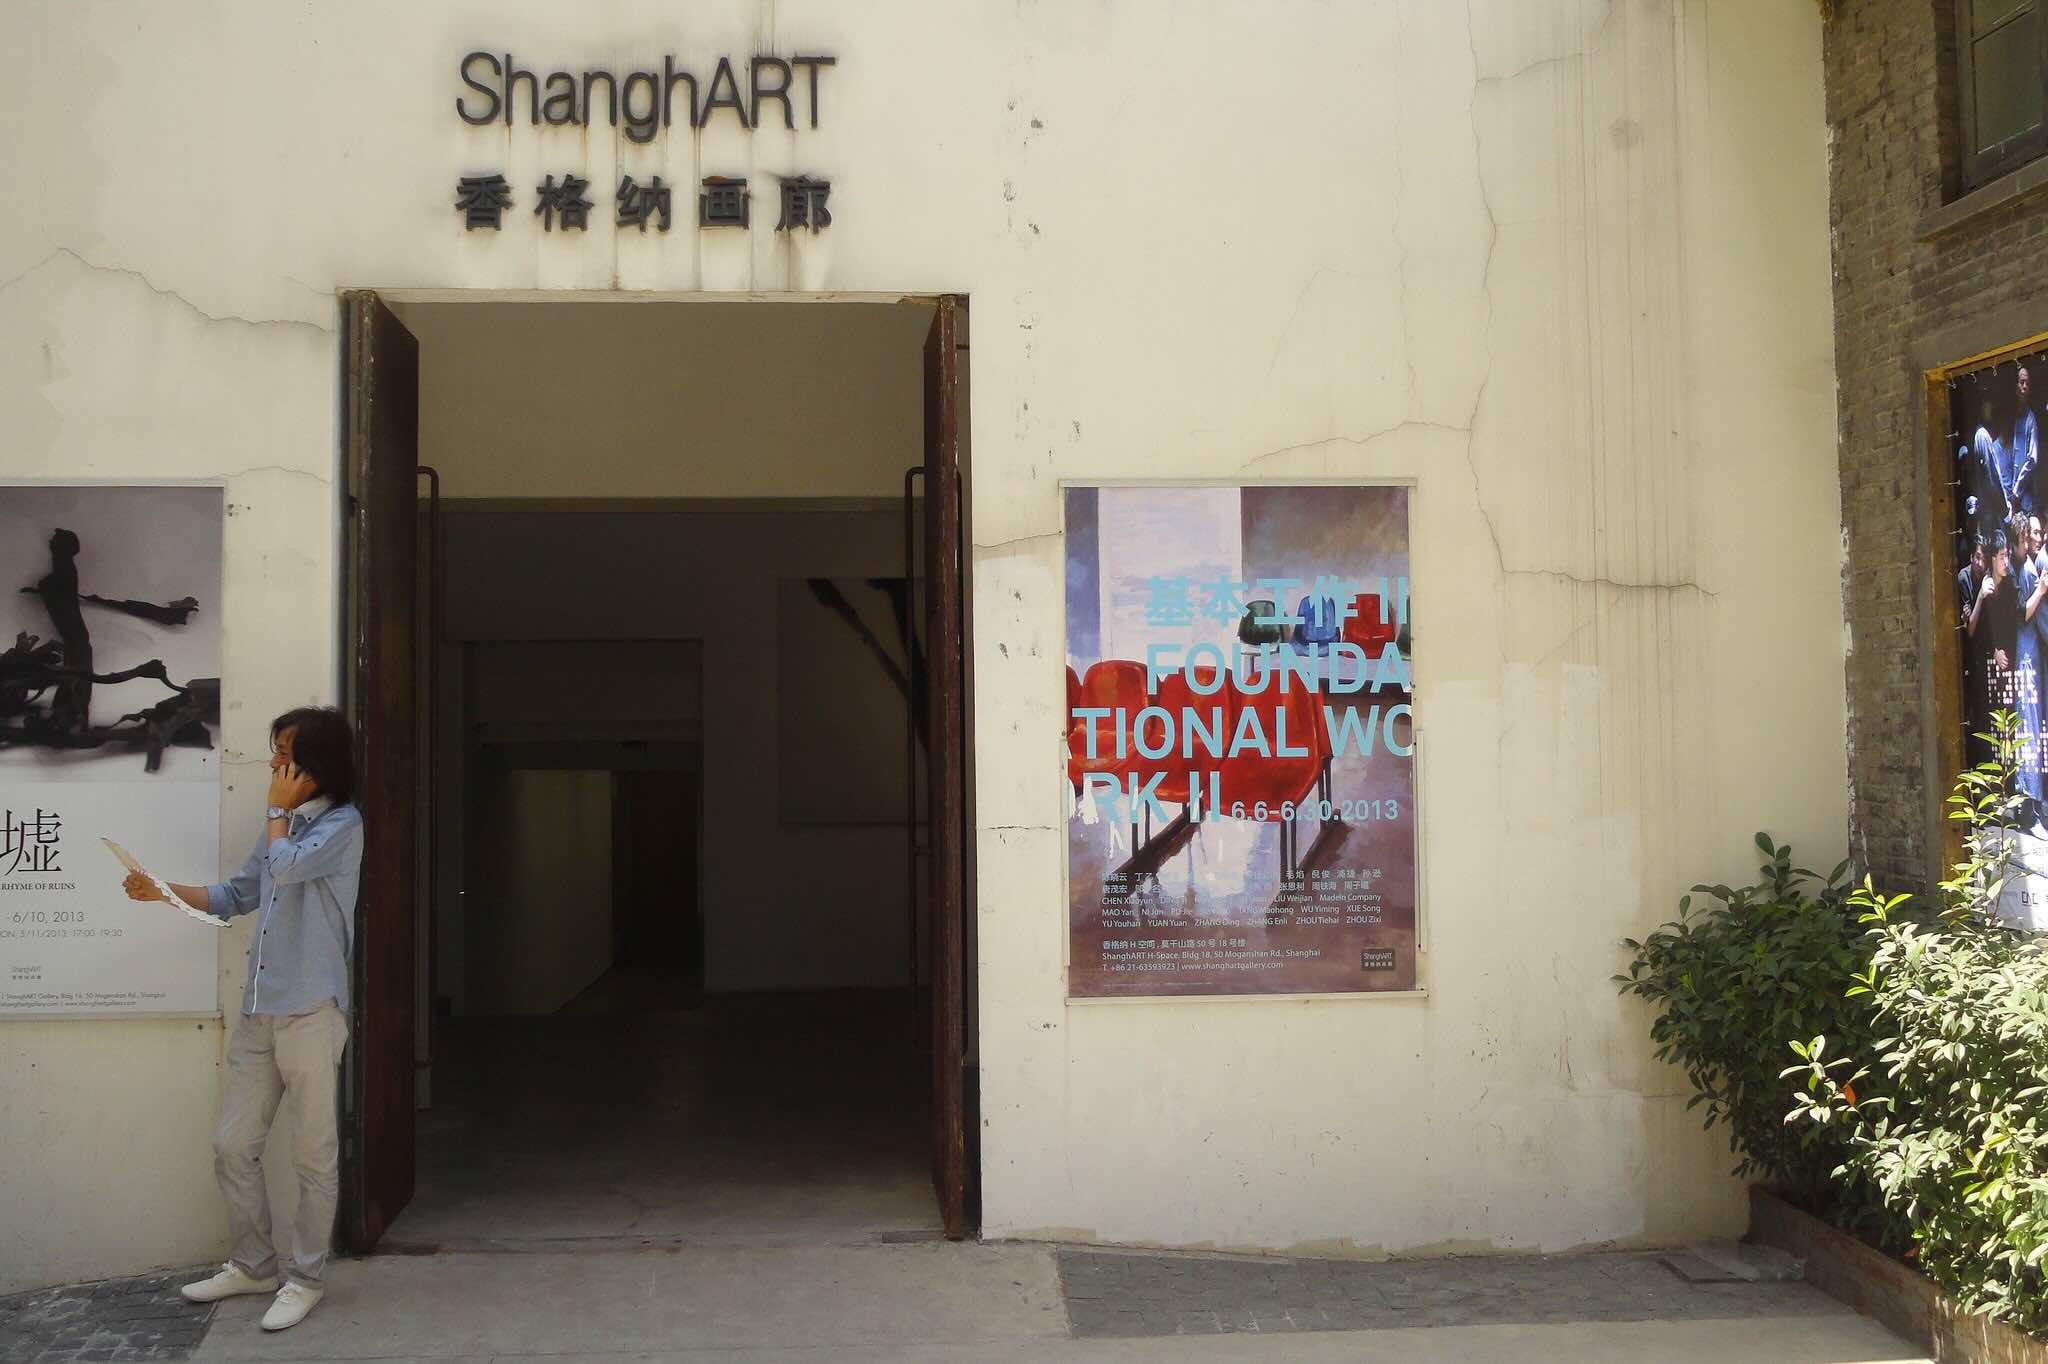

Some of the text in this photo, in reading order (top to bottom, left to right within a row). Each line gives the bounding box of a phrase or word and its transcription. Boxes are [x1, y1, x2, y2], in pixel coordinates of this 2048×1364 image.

[456, 52, 836, 143] ShanghART
[455, 174, 834, 234] 香格纳画廊
[1144, 575, 1360, 627] 基本工作
[1147, 642, 1411, 696] FOUNDA
[1071, 704, 1412, 759] TIONAL WO
[1231, 800, 1399, 823] 6.6-6.30.2013
[0, 808, 63, 876] 墟
[1102, 897, 1122, 905] CHEN
[1288, 895, 1312, 903] Weijian
[1348, 894, 1381, 903] Company
[1301, 905, 1314, 913] WU
[1315, 905, 1339, 914] Yiming
[1347, 904, 1361, 912] XUE
[1362, 904, 1381, 913] Song
[54, 911, 84, 923] 2013
[1113, 919, 1141, 928] Youhan
[1148, 919, 1168, 927] YUAN
[1169, 919, 1188, 927] Yuan
[1102, 952, 1145, 961] ShanghART
[1214, 950, 1223, 958] 50
[1225, 950, 1268, 960] Moganshan
[1286, 949, 1321, 959] Shanghai
[1182, 961, 1284, 971] www.shanghartgallery.com
